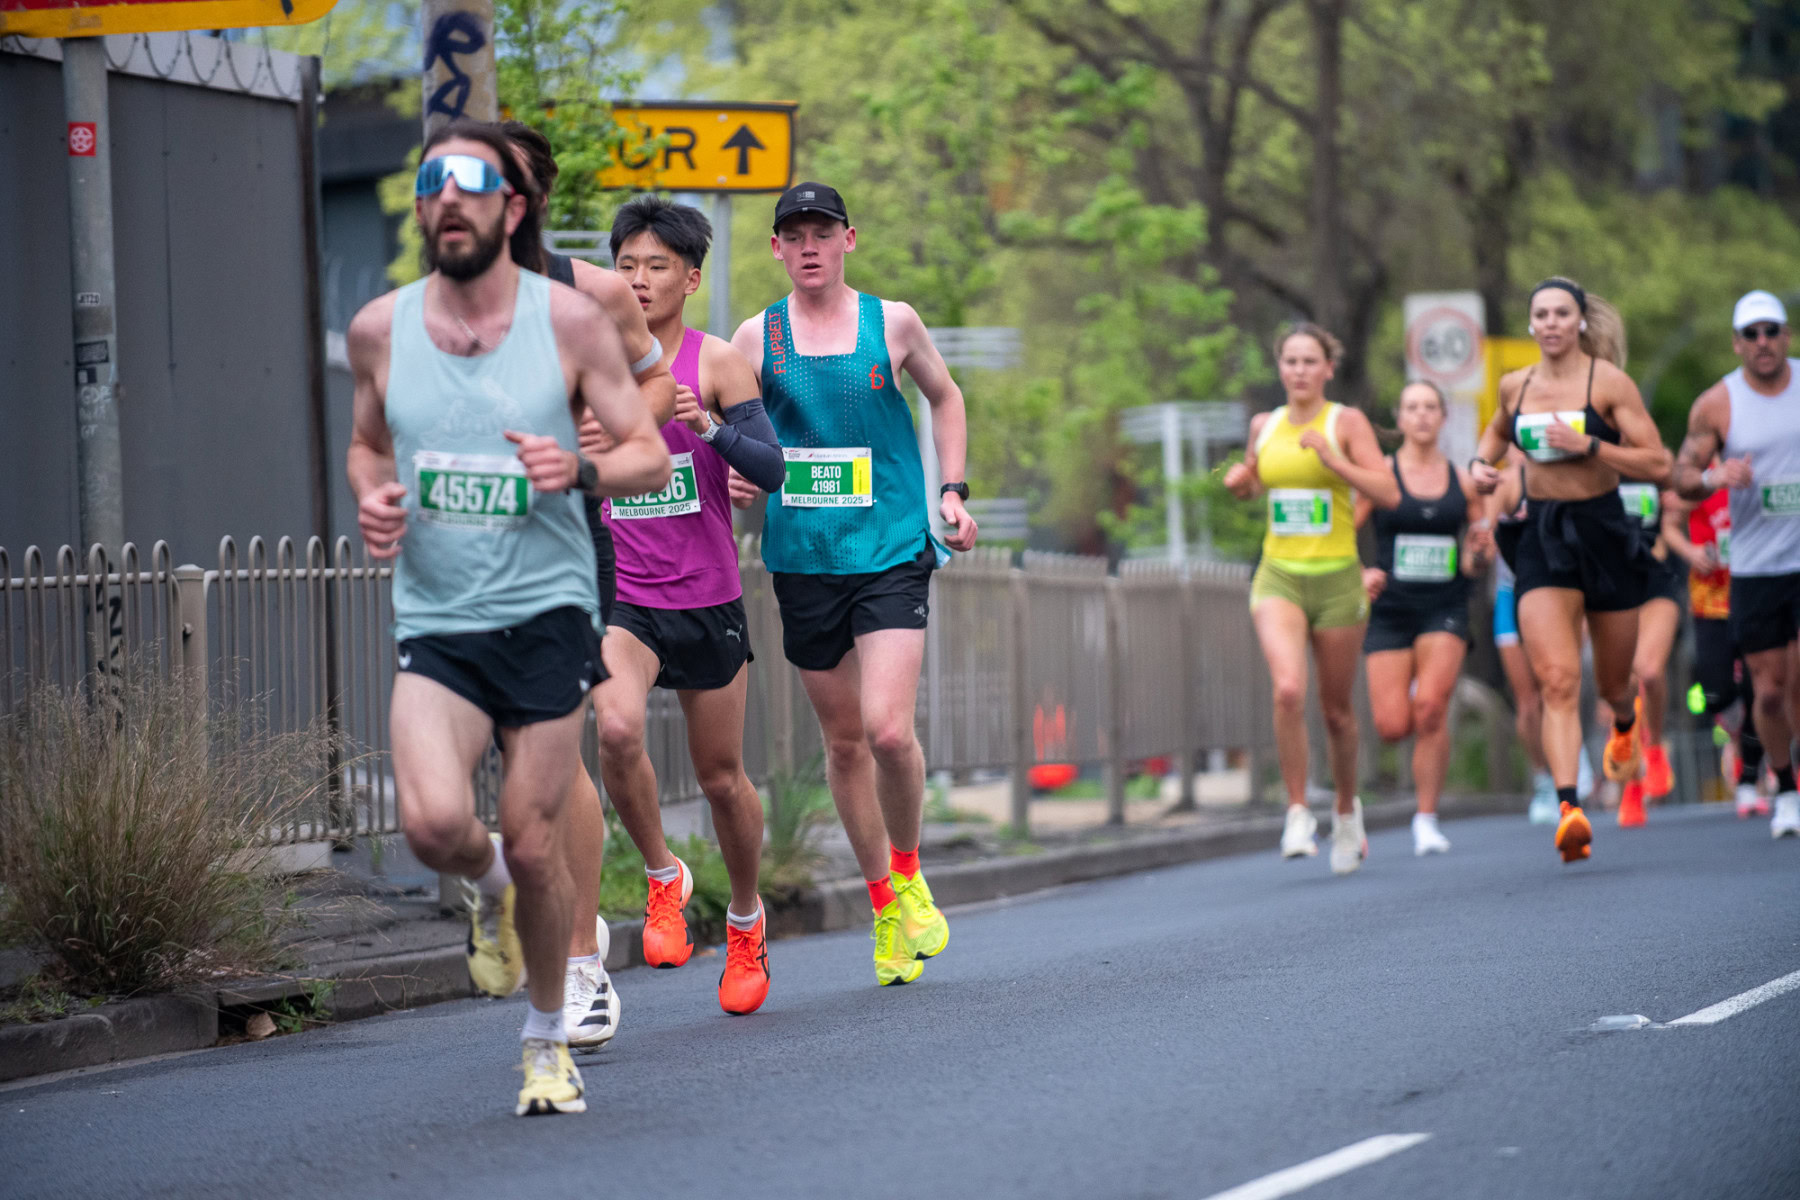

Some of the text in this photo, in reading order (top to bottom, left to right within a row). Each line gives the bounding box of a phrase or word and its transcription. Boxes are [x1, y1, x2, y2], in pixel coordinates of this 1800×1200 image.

[768, 312, 787, 375] FLIPBELT
[811, 465, 842, 479] BEATO
[428, 473, 519, 515] 45574
[811, 480, 841, 494] 41981
[791, 496, 864, 505] MELBOURNE 2025
[619, 502, 691, 517] MELBOURNE 2025
